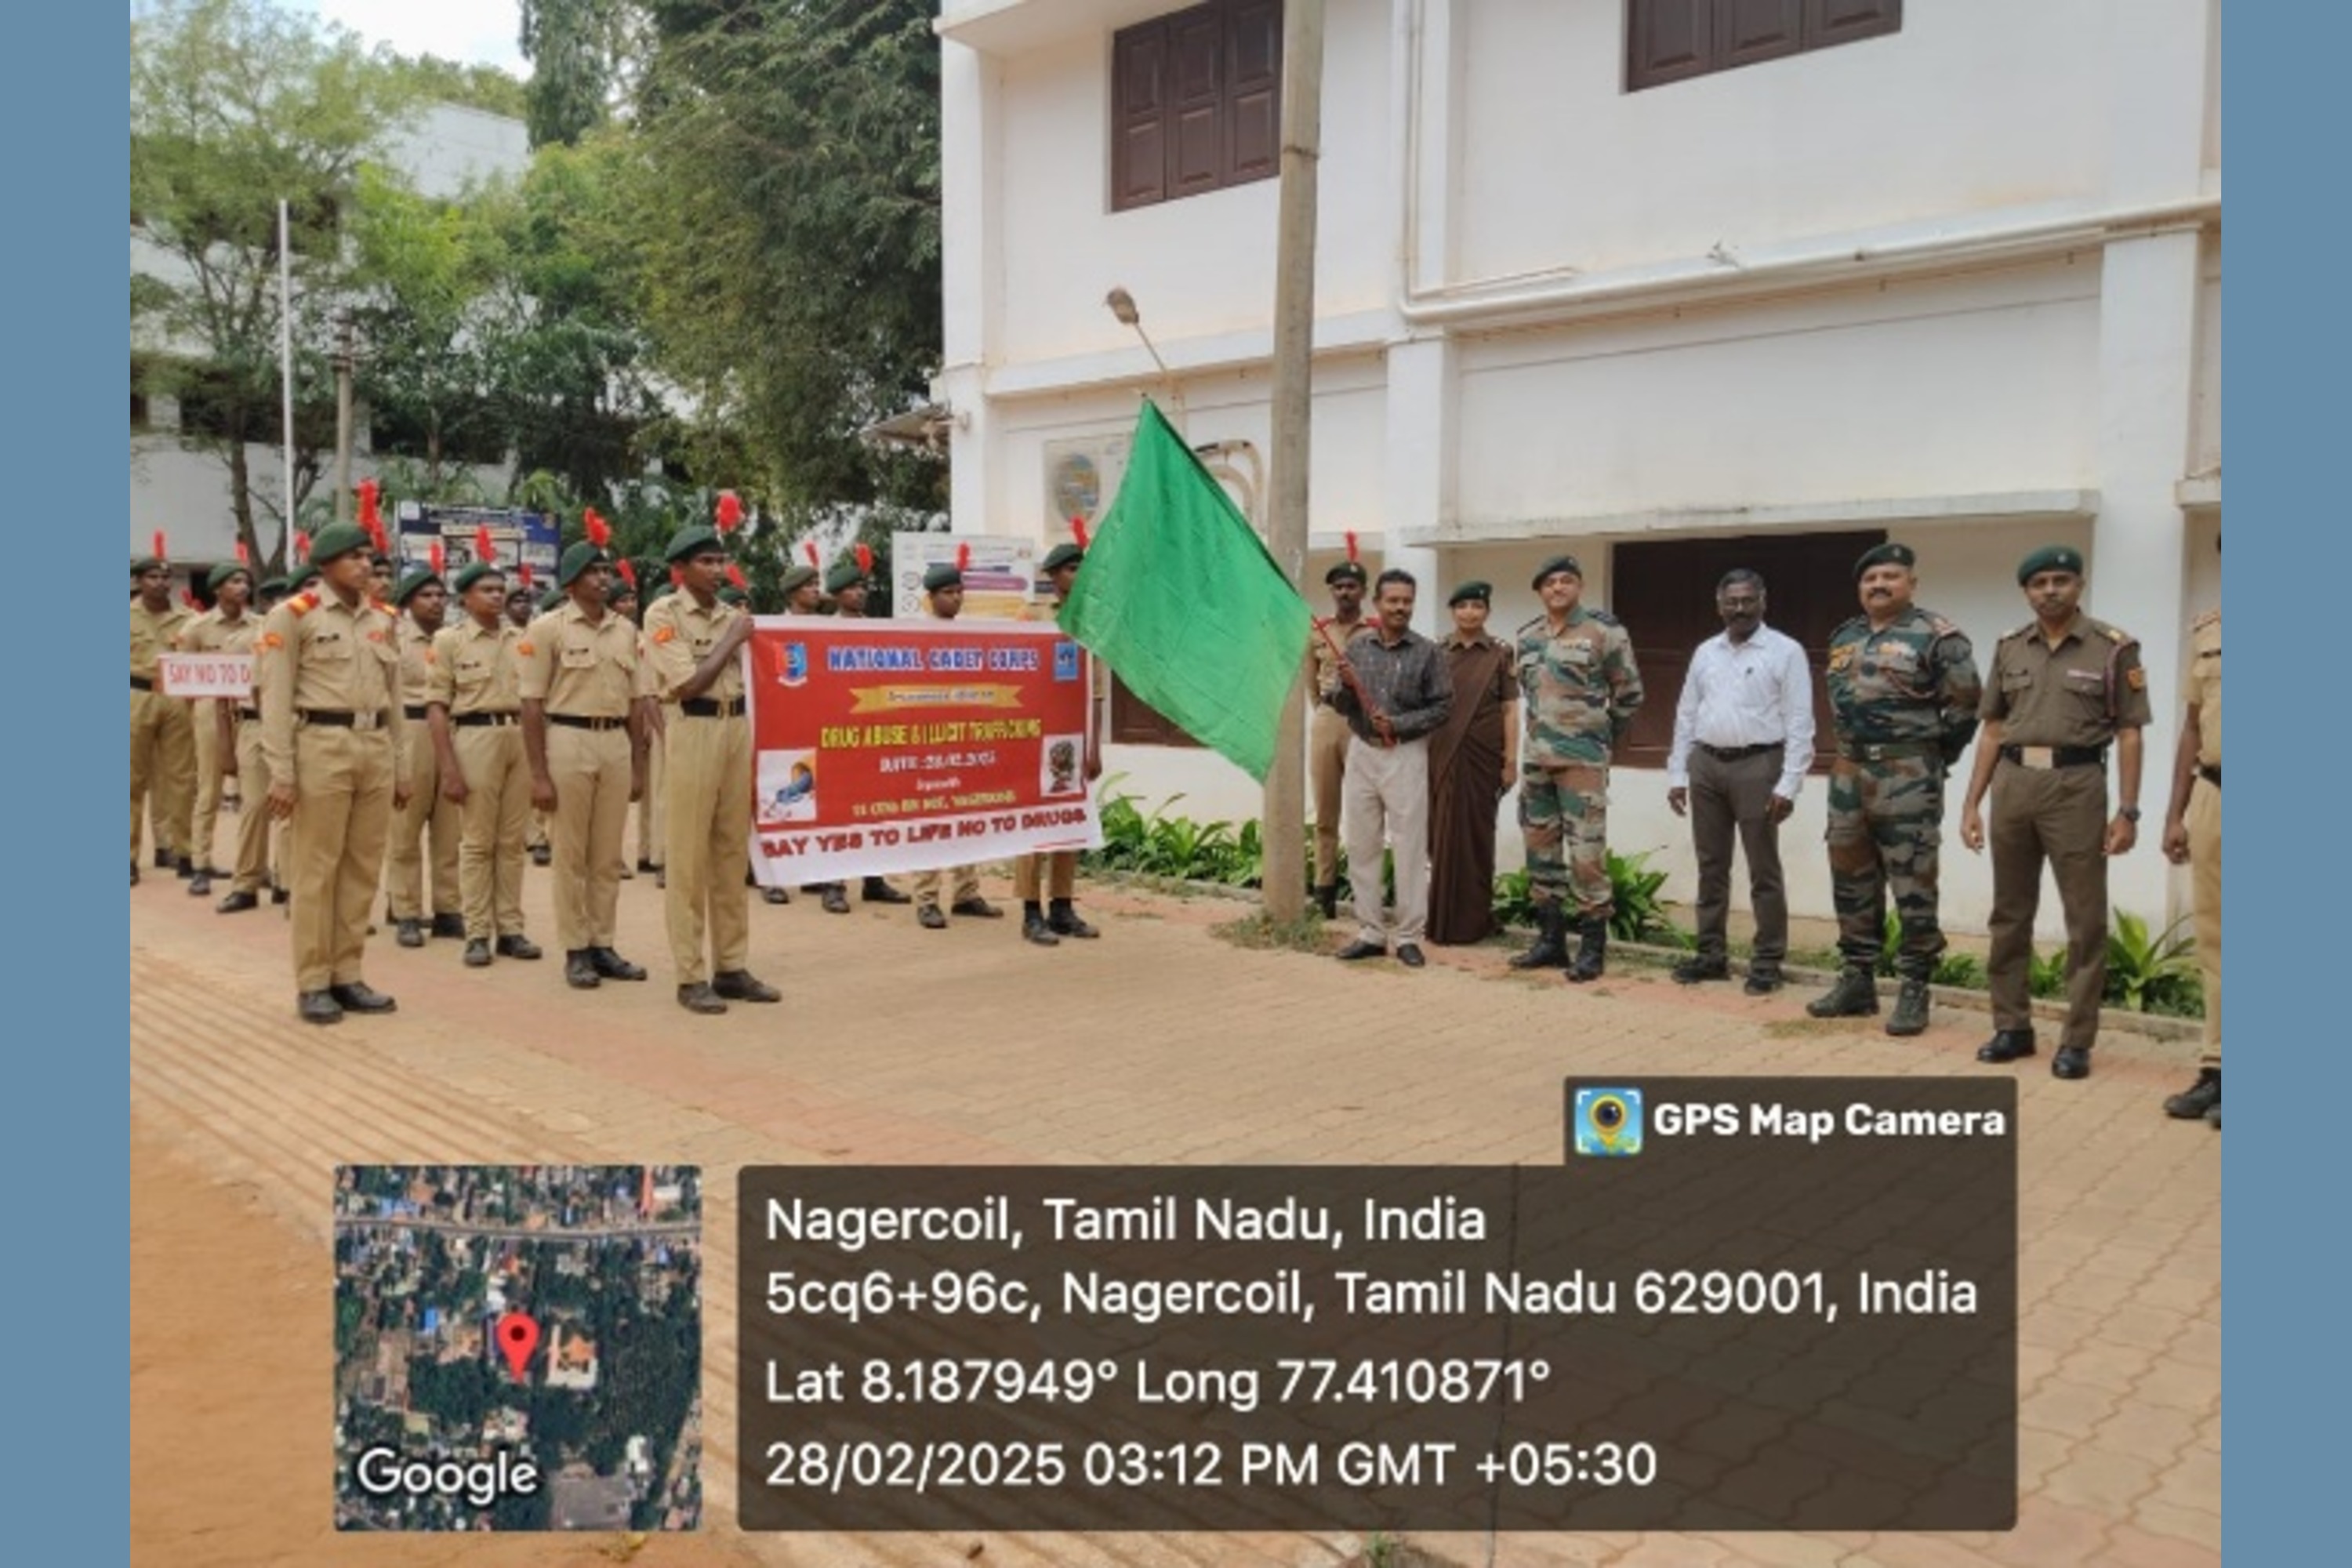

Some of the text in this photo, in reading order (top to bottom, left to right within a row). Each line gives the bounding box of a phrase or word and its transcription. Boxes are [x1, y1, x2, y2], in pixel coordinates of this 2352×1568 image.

[828, 646, 1040, 671] NATIONAL CADET CORPS
[194, 663, 217, 684] NO
[219, 663, 237, 684] TO
[821, 726, 859, 748] DRUG
[864, 724, 908, 746] ABUSE
[761, 808, 1087, 858] SAY YES TO LIFE NO TO DRUGS
